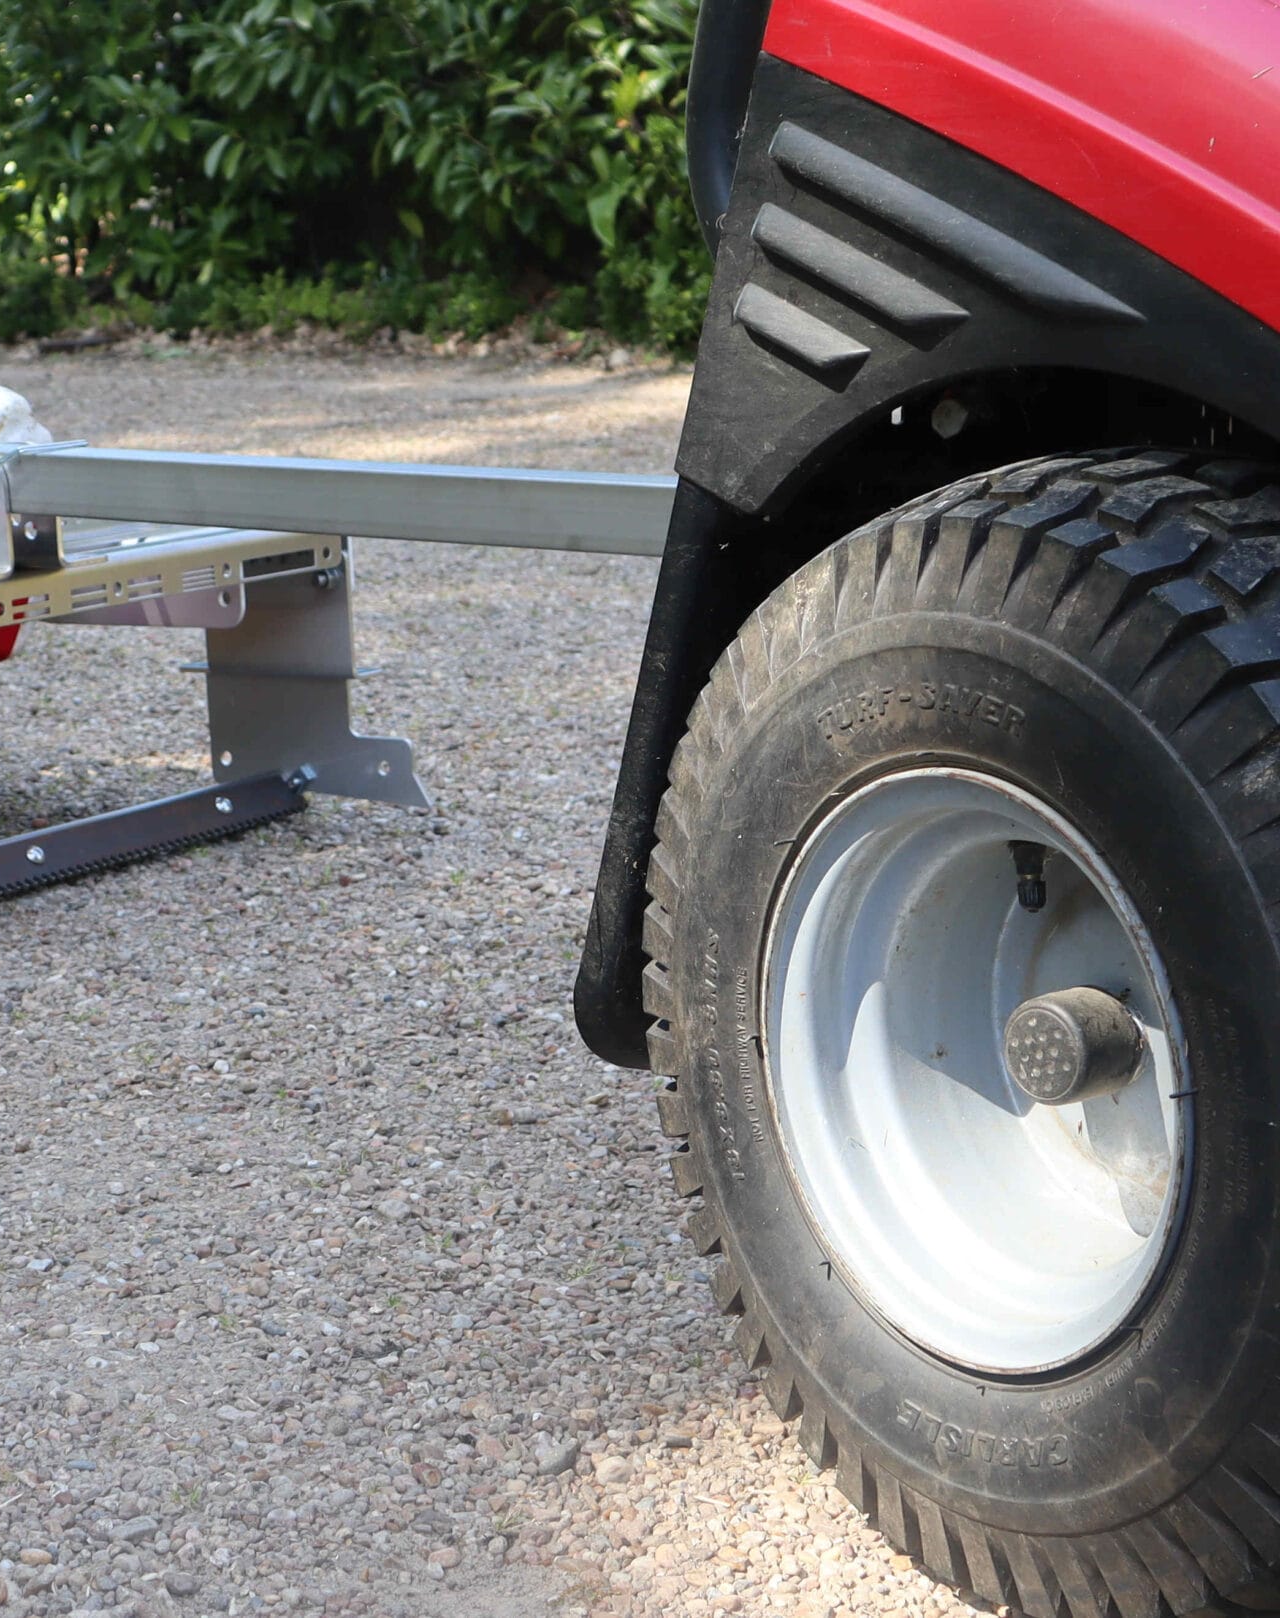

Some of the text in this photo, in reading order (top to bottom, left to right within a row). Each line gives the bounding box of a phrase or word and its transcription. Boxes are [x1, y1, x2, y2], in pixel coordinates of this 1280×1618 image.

[817, 681, 1028, 740] TURF-SAVER
[735, 965, 765, 1142] NOT FOR HIGHWAY SERVICE
[895, 1399, 1070, 1467] CARLISLE
